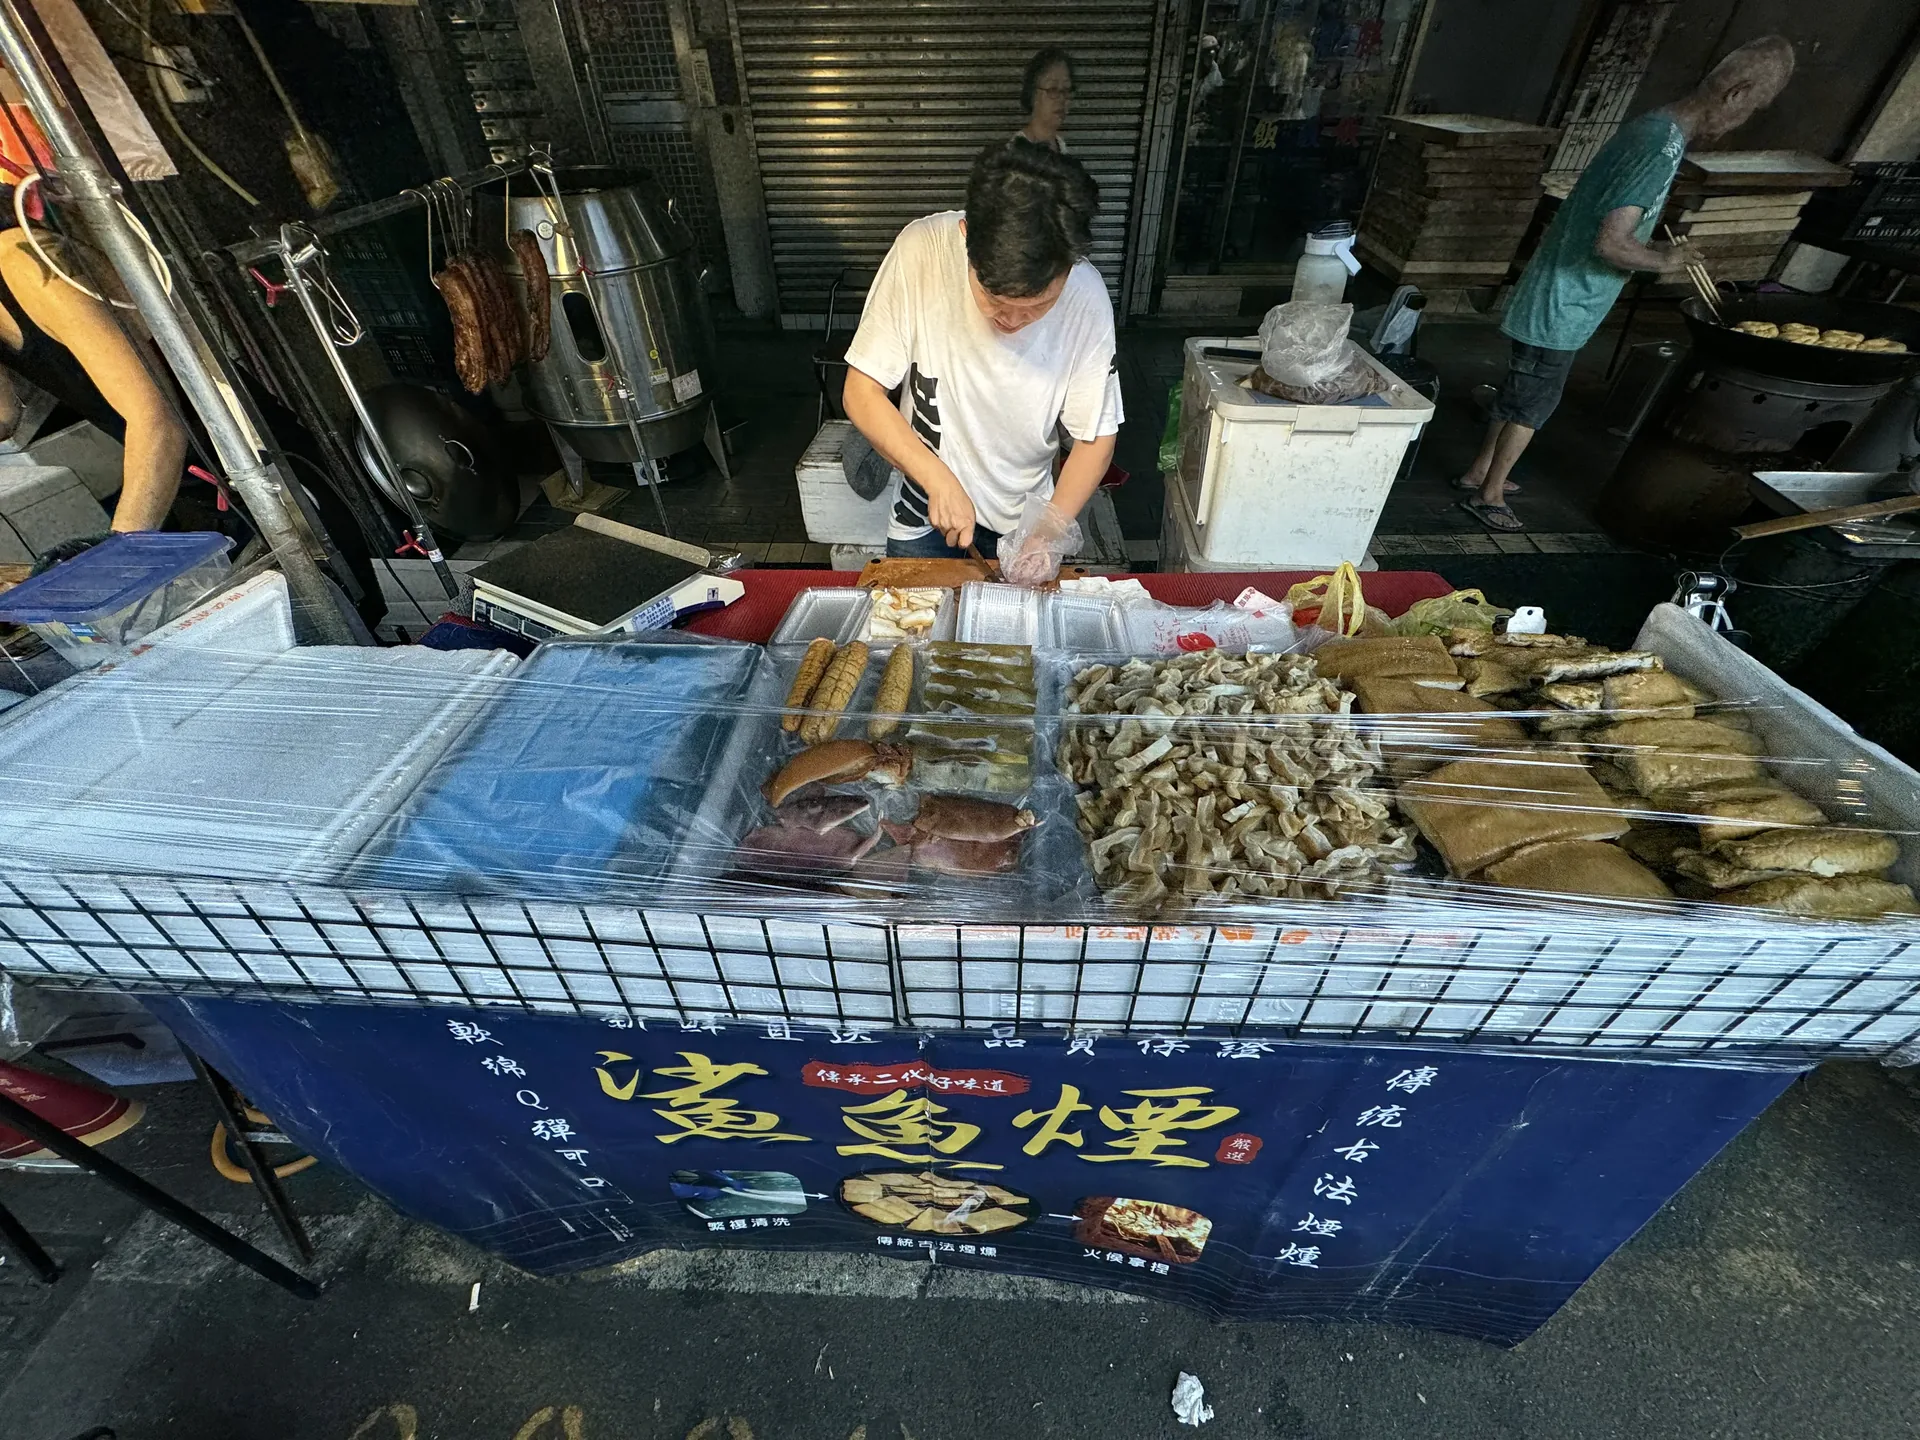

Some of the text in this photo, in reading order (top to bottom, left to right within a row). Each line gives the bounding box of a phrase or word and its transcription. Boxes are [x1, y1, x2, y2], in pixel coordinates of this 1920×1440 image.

[446, 1019, 606, 1188] 軟綿Q彈可口
[592, 1050, 1241, 1170] 鯊魚煙
[816, 1067, 1008, 1093] 傳承二代好味道
